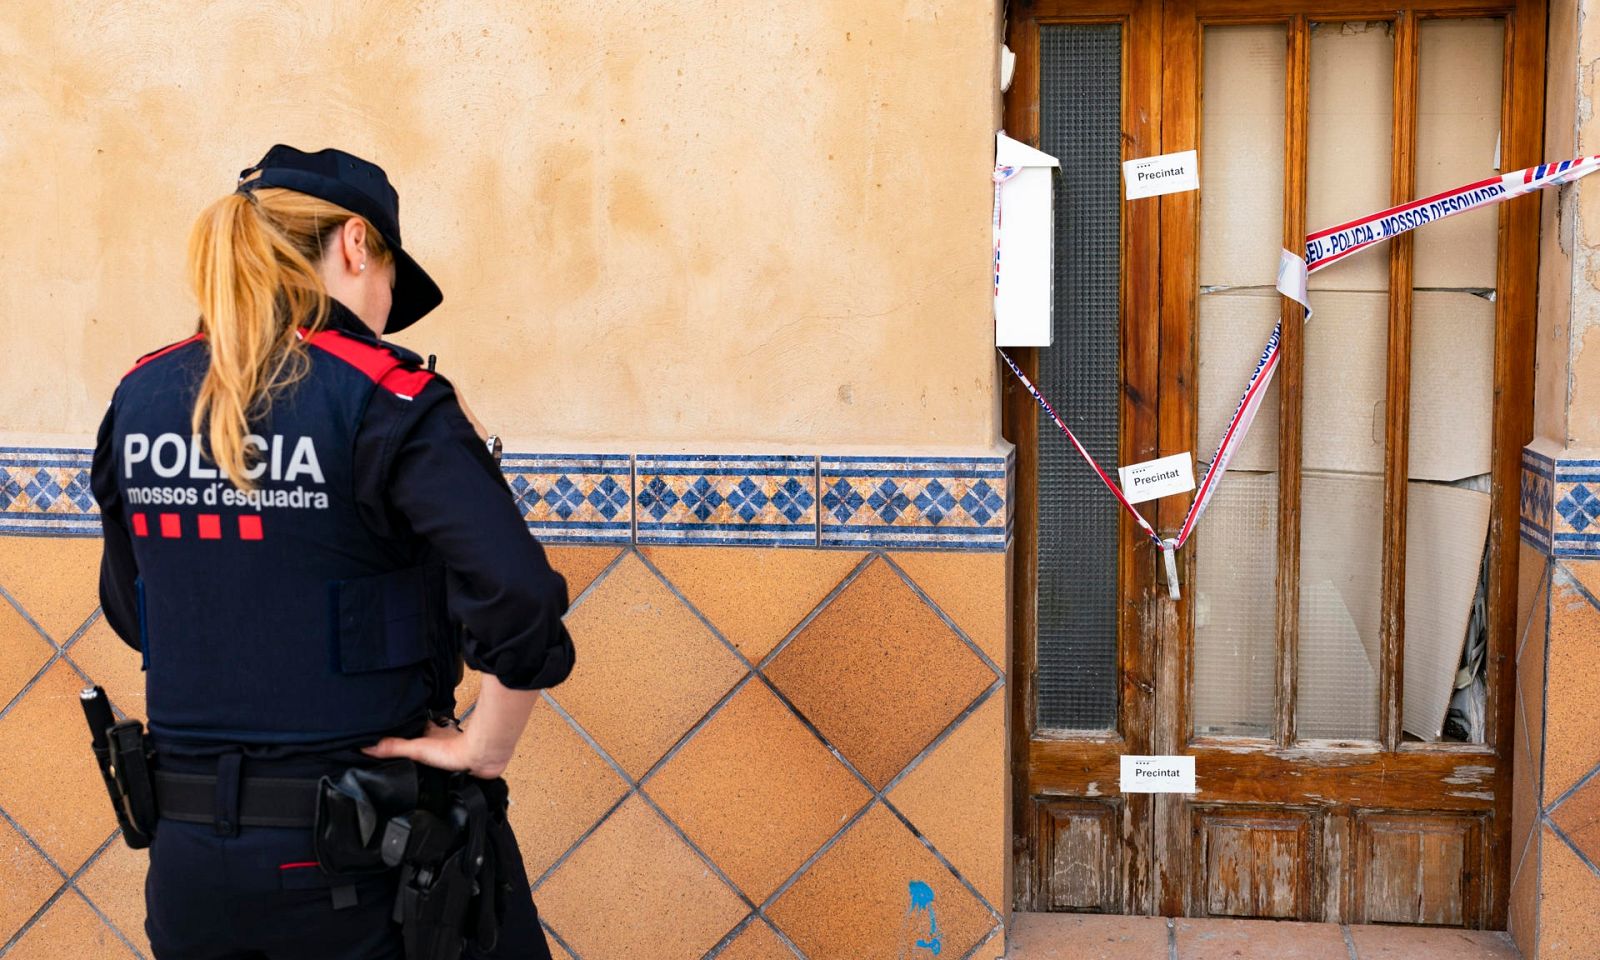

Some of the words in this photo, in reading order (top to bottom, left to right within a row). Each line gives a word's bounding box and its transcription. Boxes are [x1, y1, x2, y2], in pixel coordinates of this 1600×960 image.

[1137, 166, 1184, 181] Precintat
[1330, 225, 1374, 254] POLICIA
[1381, 207, 1430, 238] MOSSOS
[124, 432, 325, 484] POLCIA
[1133, 469, 1180, 486] Precintat
[127, 487, 198, 505] mossos
[1135, 768, 1180, 777] Precintat
